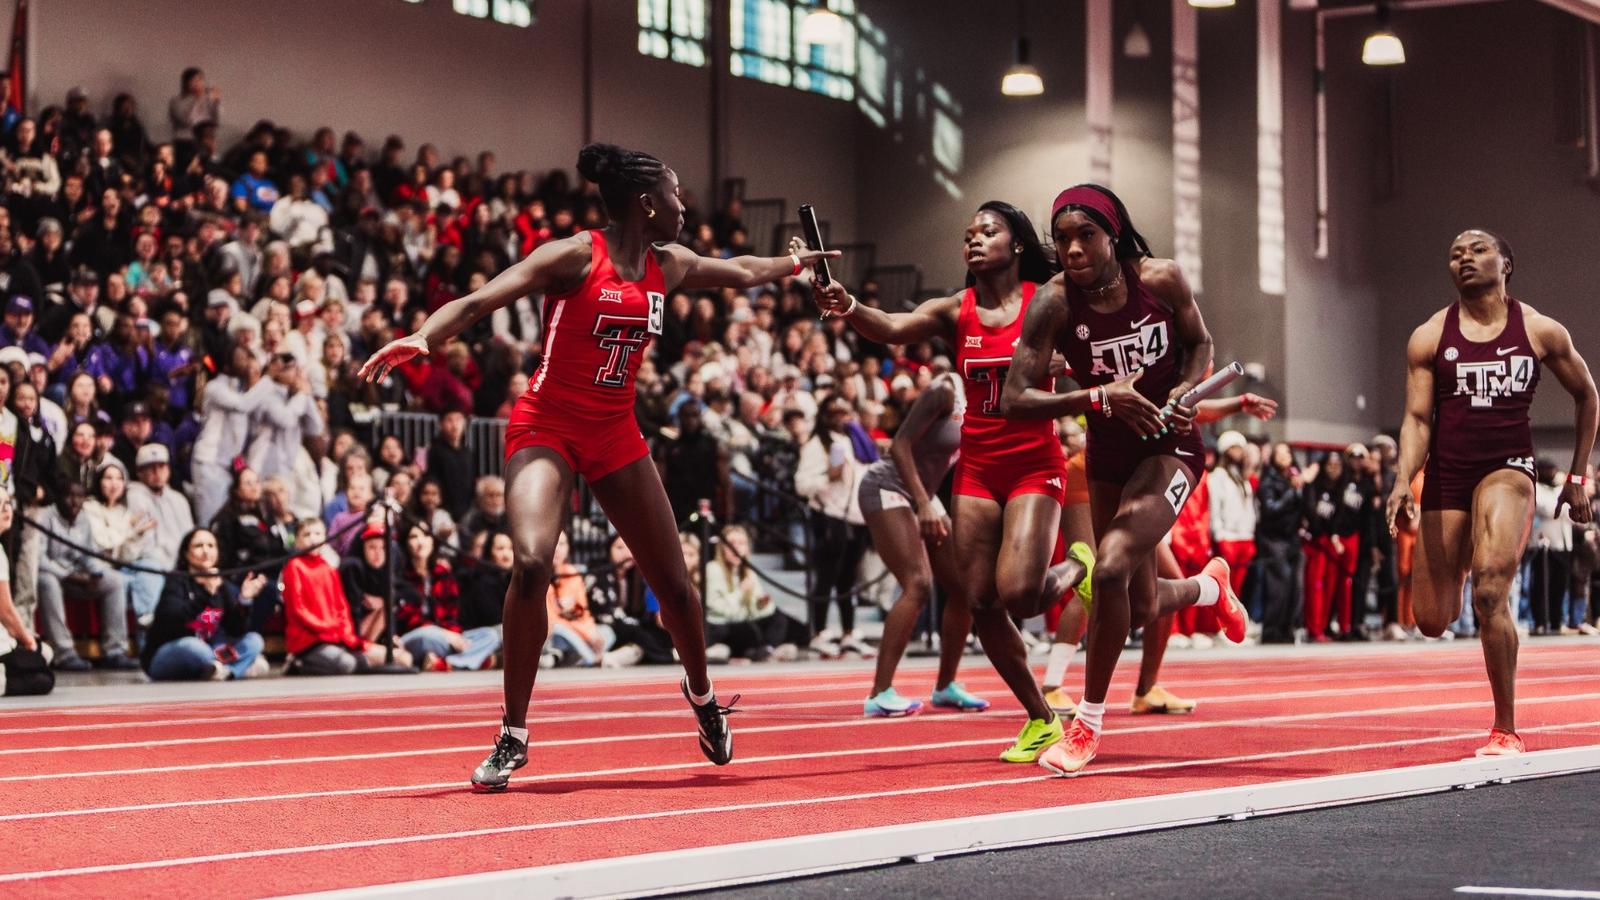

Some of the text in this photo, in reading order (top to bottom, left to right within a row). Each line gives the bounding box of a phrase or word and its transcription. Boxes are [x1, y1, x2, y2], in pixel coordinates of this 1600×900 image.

[650, 294, 663, 331] 5
[1146, 325, 1165, 358] 4
[1514, 359, 1529, 390] 4
[1170, 481, 1187, 507] 4
